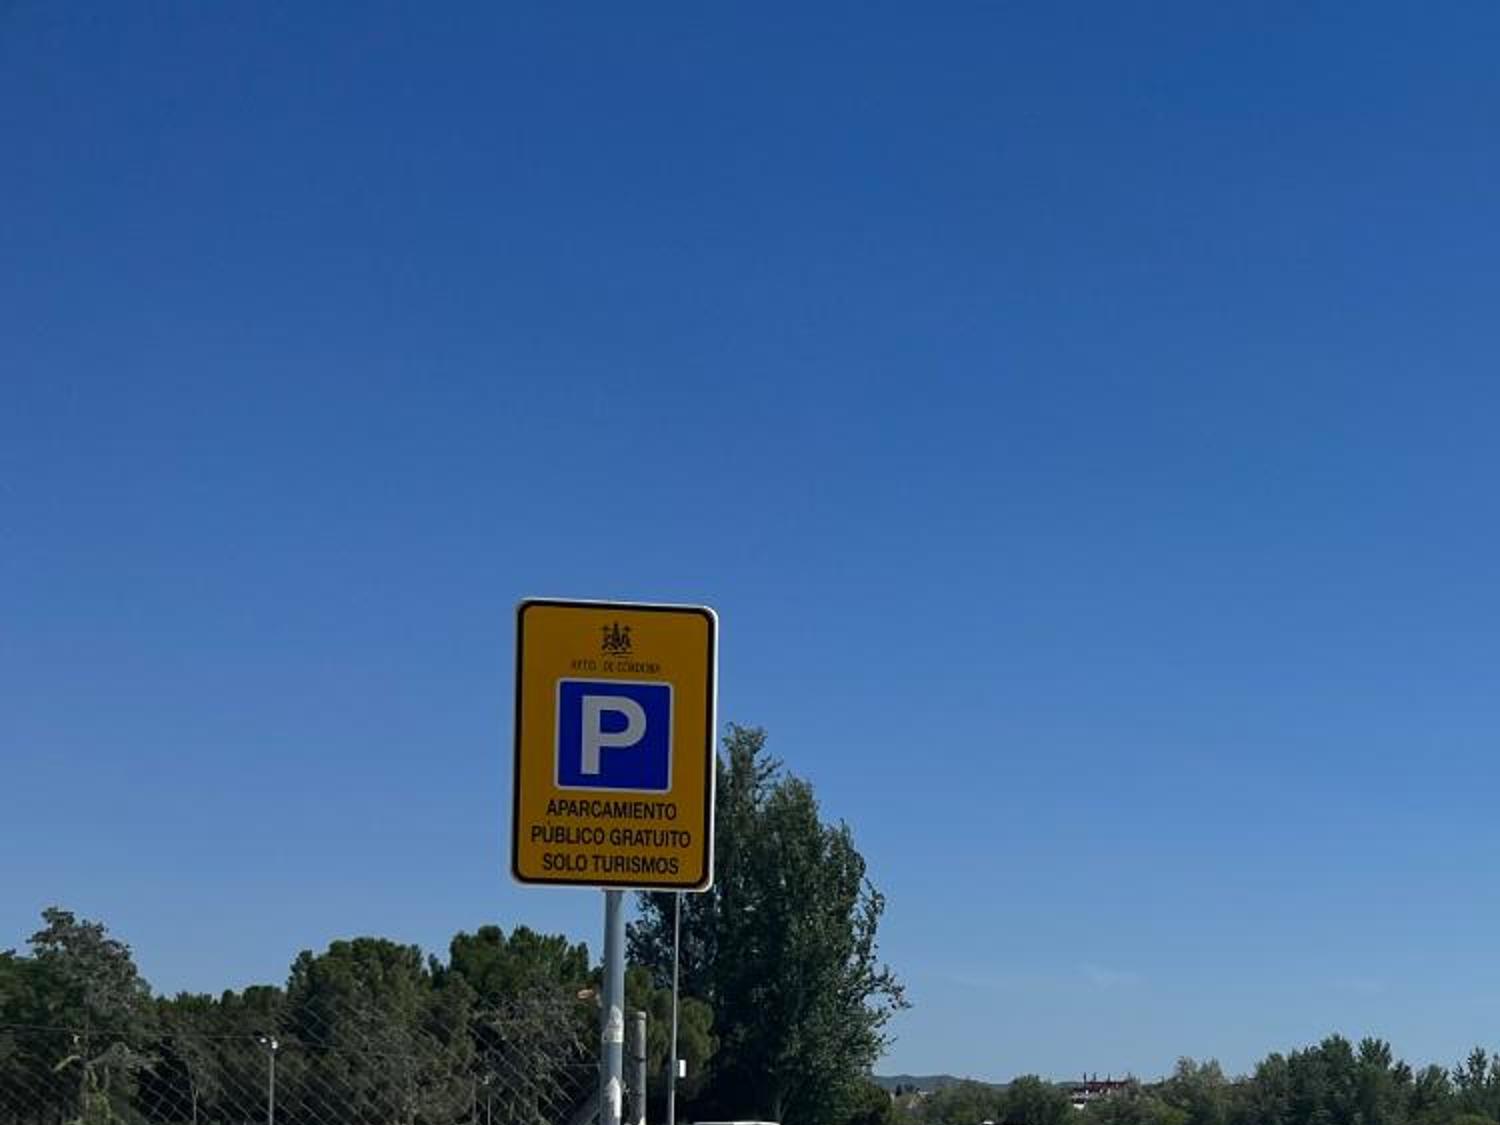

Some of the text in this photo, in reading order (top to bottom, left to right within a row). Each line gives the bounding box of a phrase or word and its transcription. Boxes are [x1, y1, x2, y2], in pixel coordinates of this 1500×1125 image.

[580, 695, 647, 776] P
[546, 799, 677, 820] APARCAMIENTO
[609, 829, 691, 848] GRATUITO
[543, 852, 679, 874] SOLO TURISMOS
